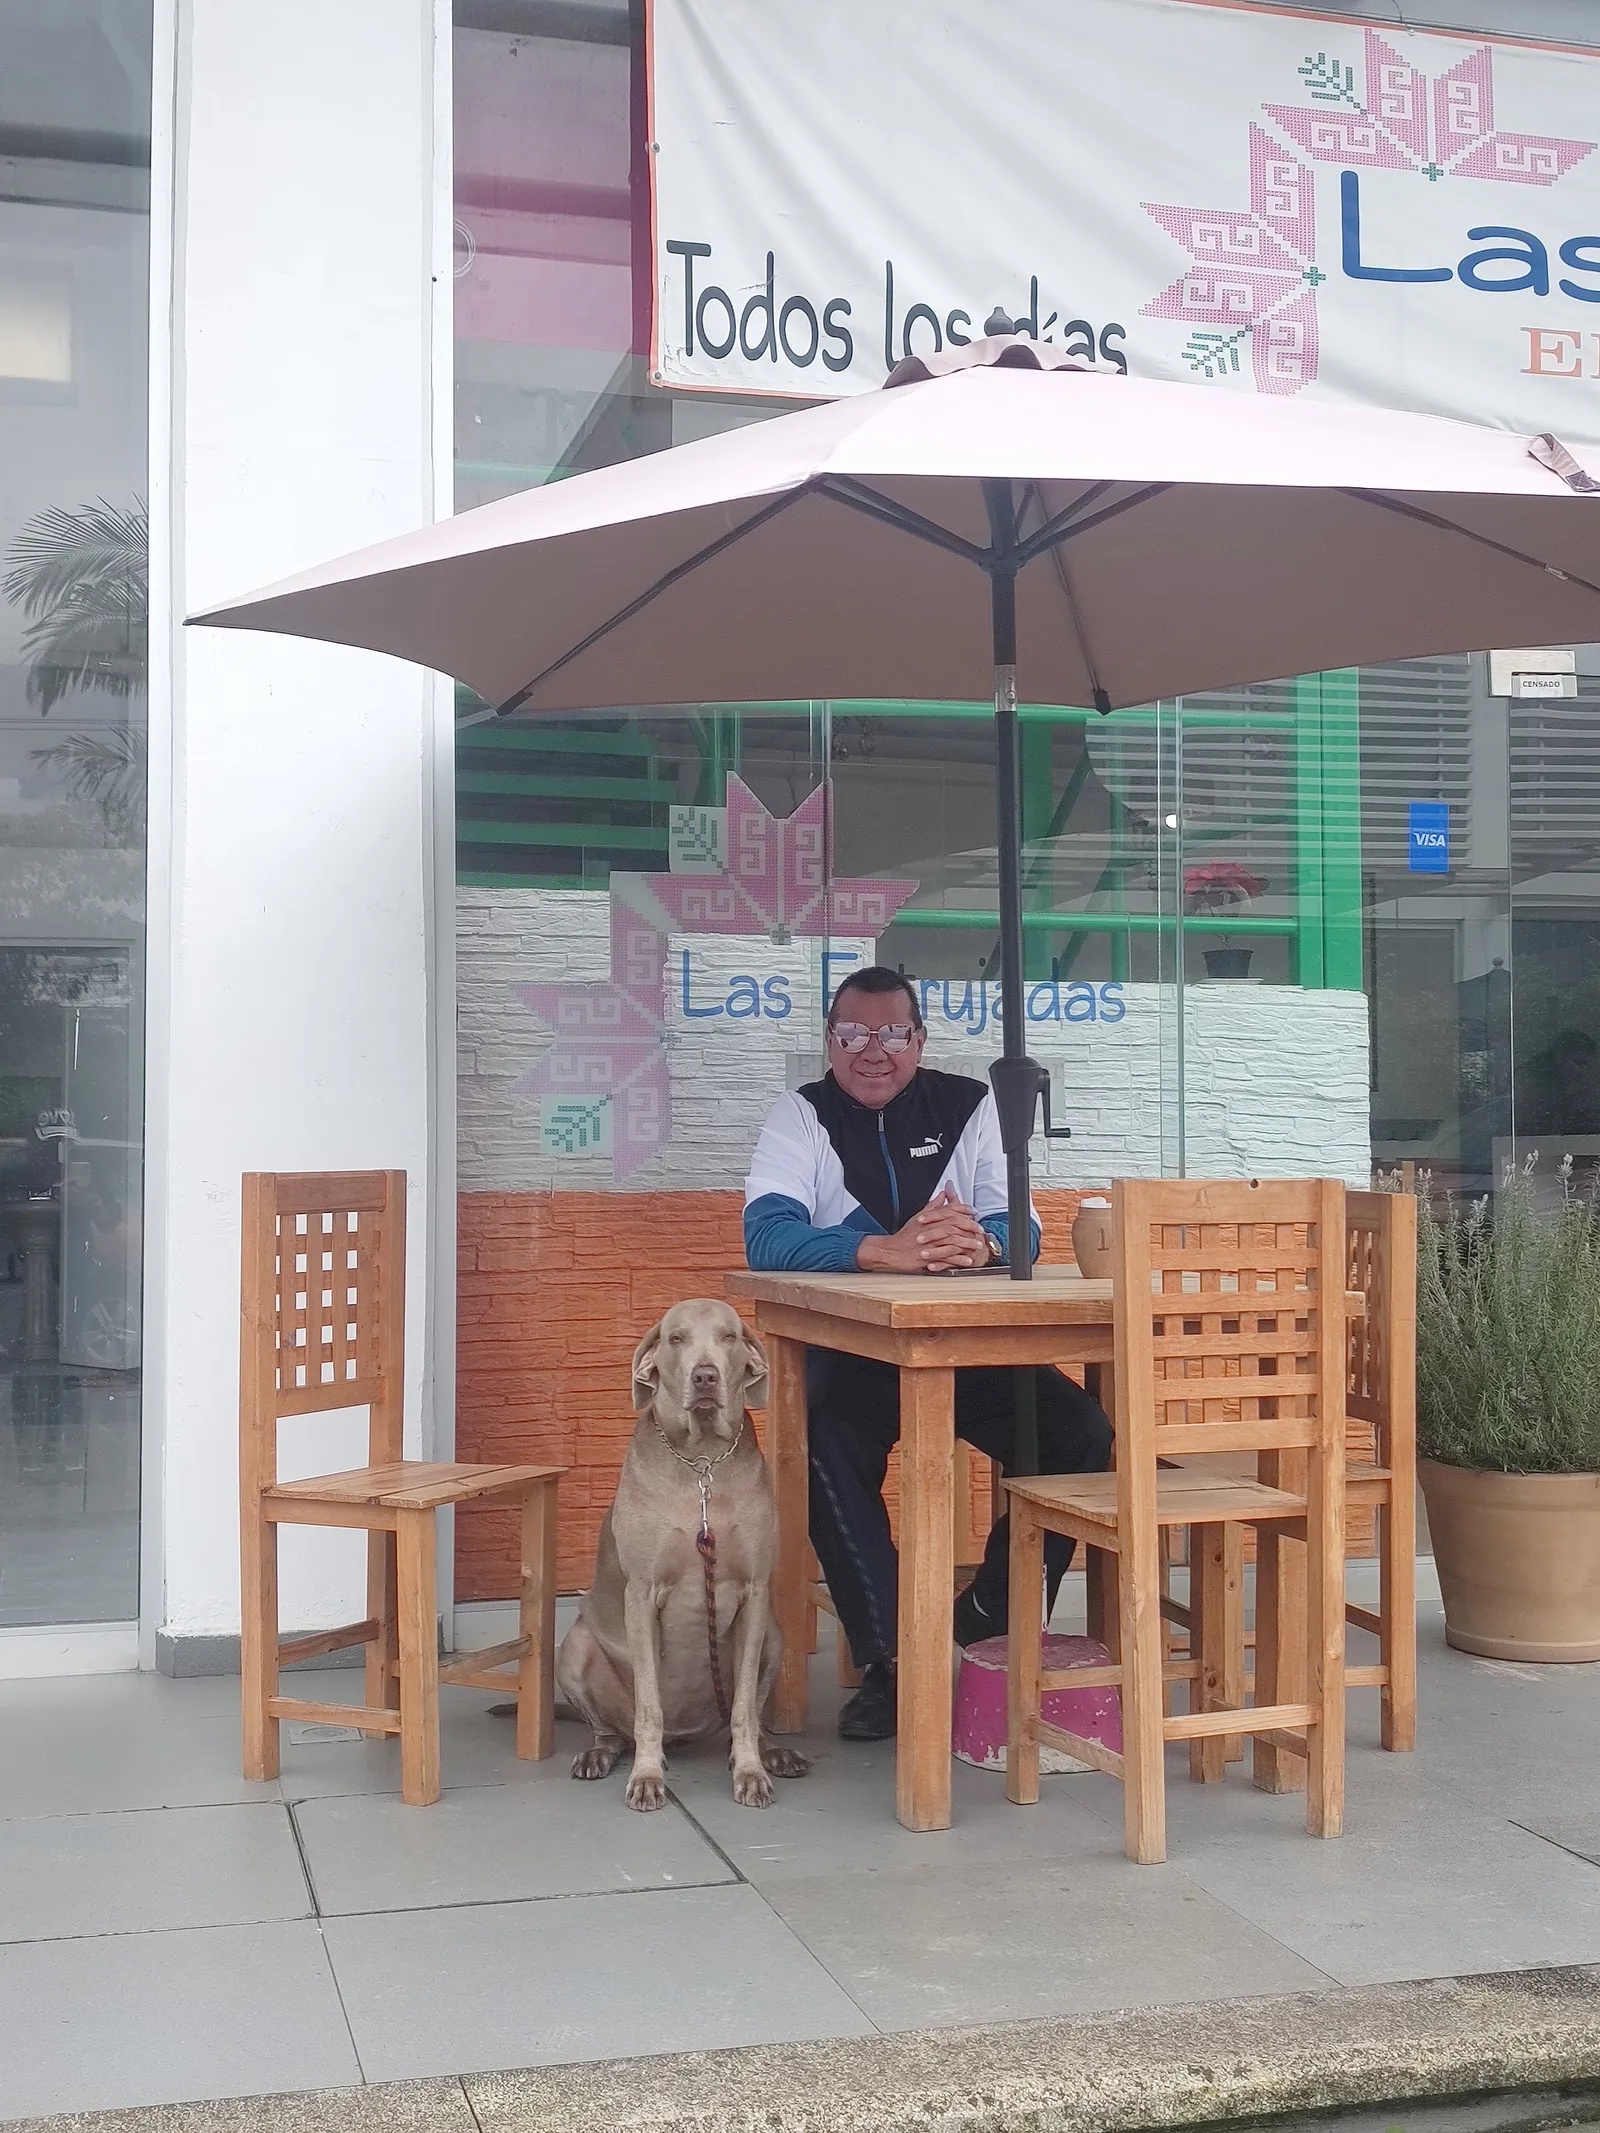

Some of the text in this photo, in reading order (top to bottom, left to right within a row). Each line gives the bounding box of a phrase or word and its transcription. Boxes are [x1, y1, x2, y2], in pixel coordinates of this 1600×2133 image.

[666, 239, 855, 371] Todos
[884, 260, 972, 373] los
[1520, 326, 1600, 379] E
[1522, 680, 1561, 688] CENSADO
[1413, 832, 1446, 847] VISA
[682, 948, 792, 1019] Las
[909, 1143, 939, 1158] PUMA
[1097, 1227, 1110, 1251] 1
